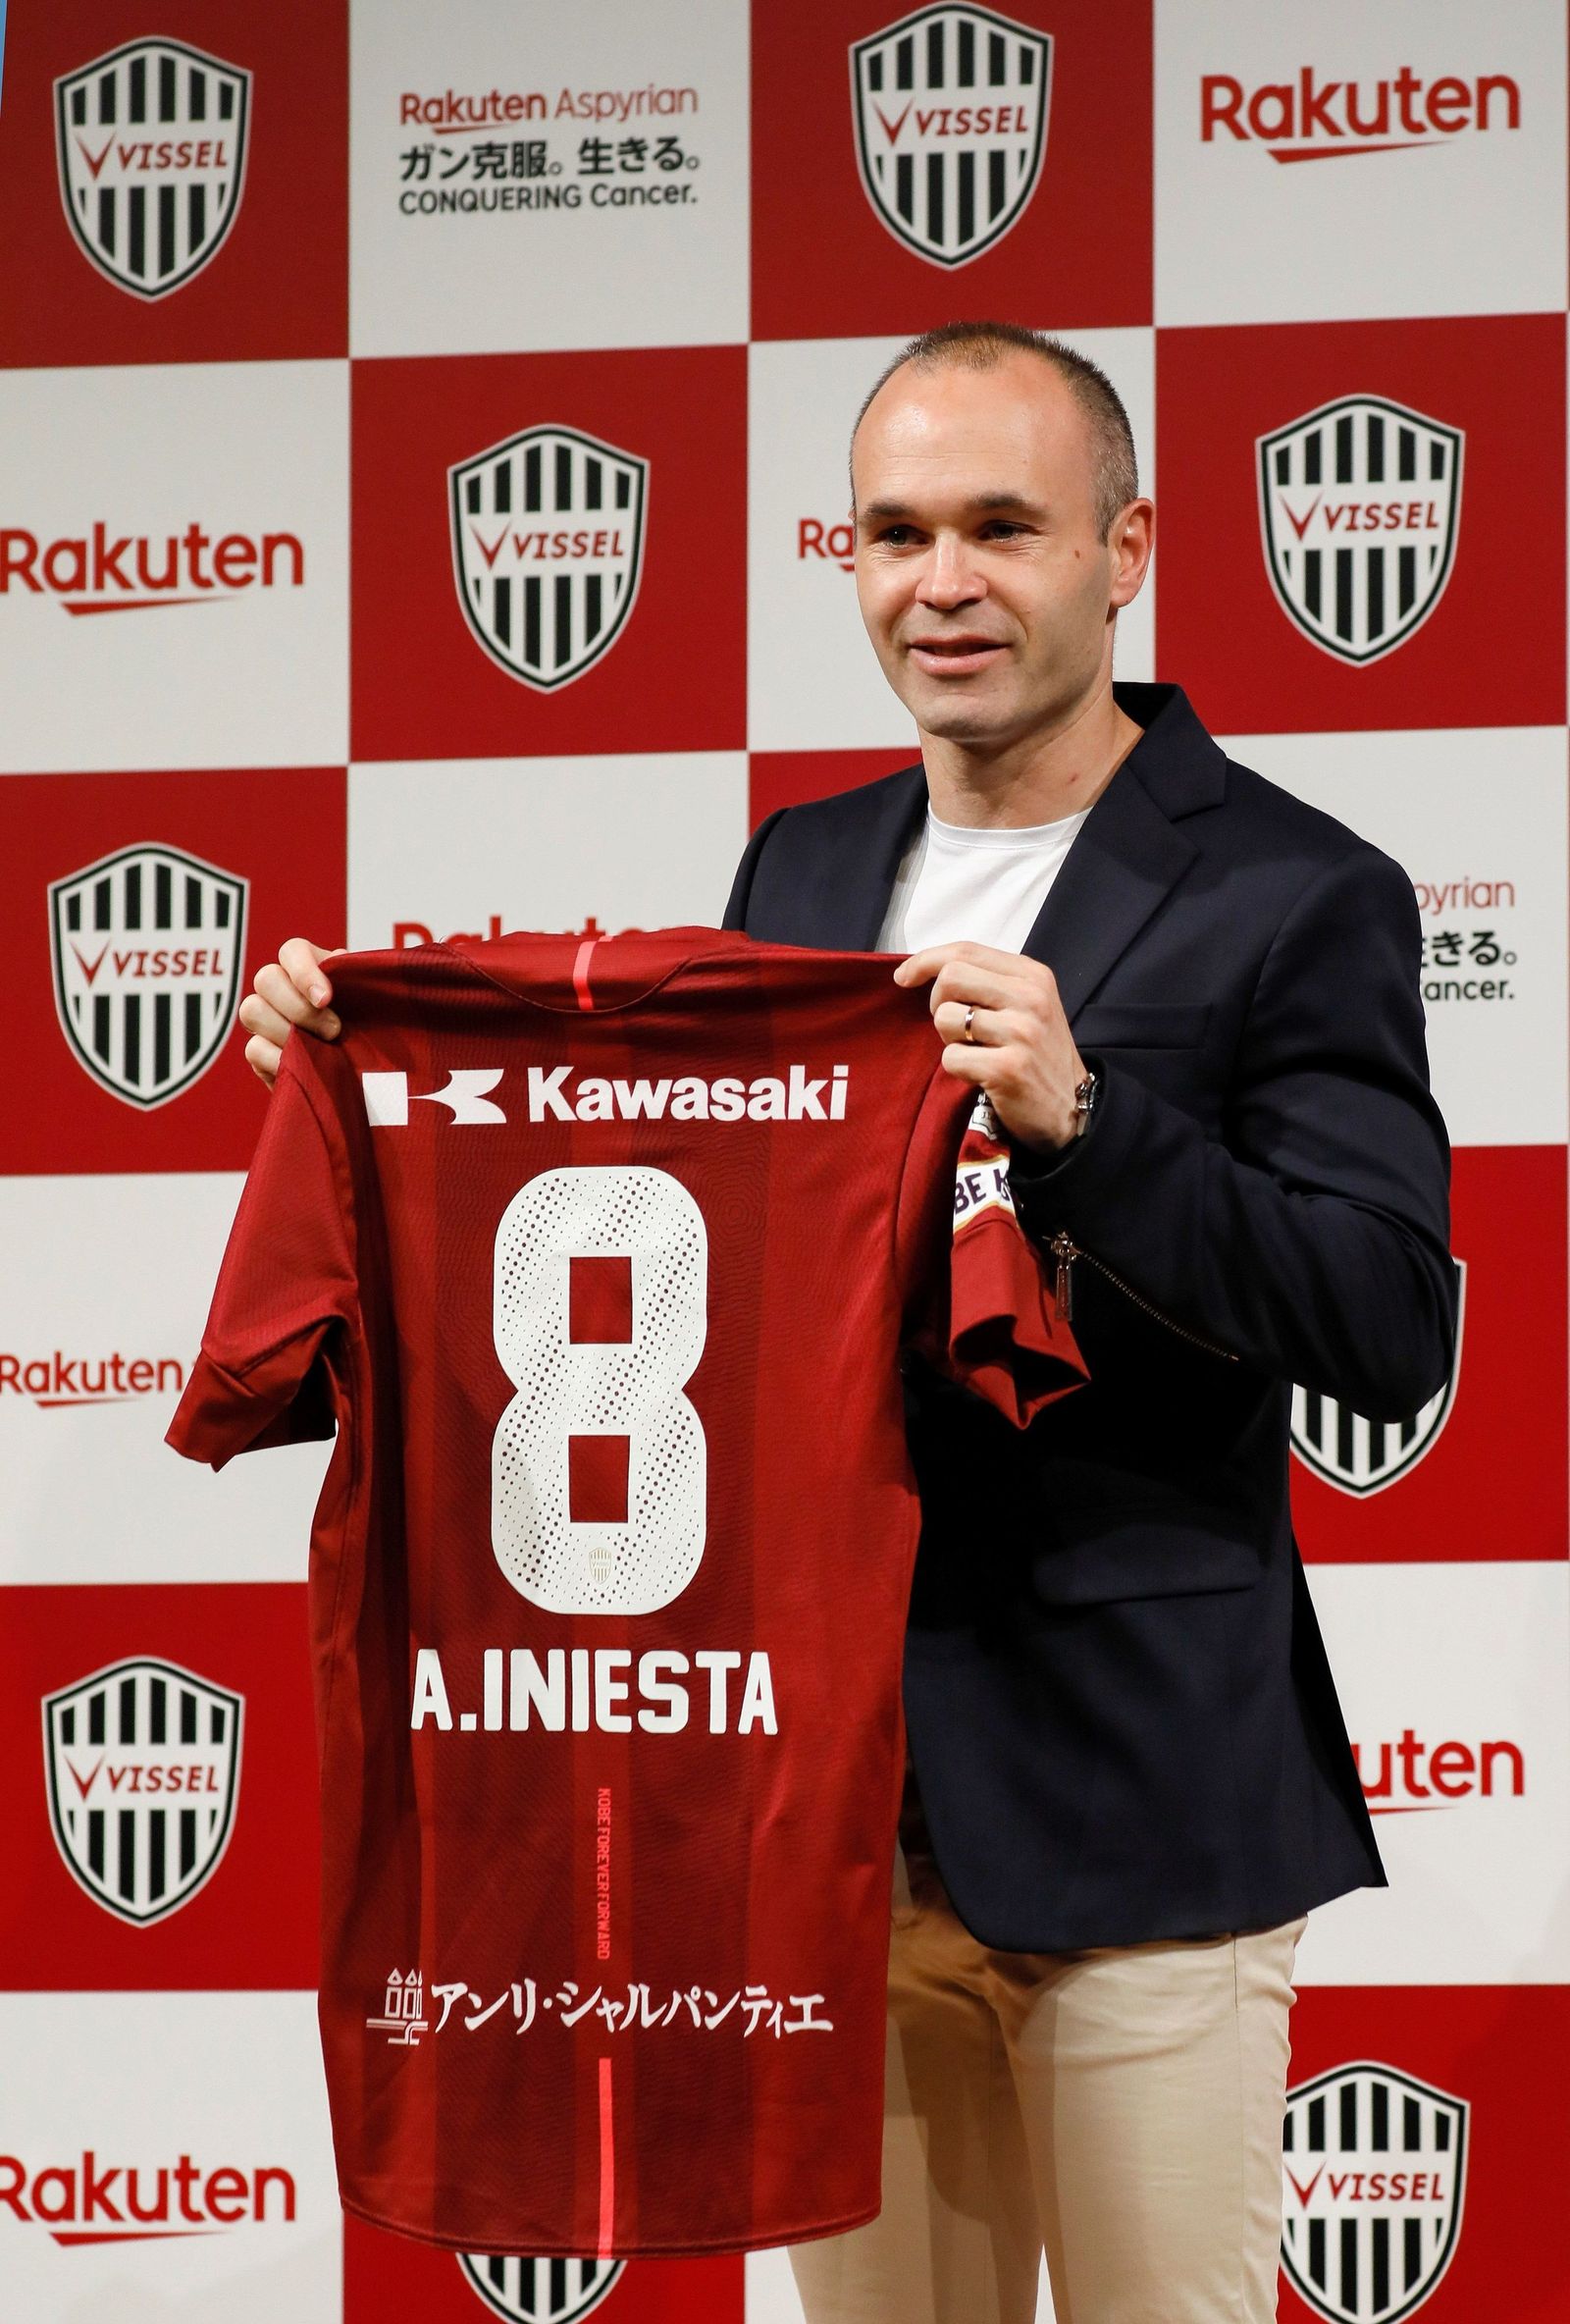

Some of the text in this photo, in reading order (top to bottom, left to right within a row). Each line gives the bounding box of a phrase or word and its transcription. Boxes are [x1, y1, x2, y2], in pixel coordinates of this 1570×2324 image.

[399, 83, 699, 125] Rakuten Aspyrian
[916, 105, 1027, 136] VISSEL
[1200, 66, 1521, 142] Rakuten
[118, 140, 228, 171] VISSEL
[398, 182, 698, 216] CONQUERING Cancer.
[1324, 501, 1439, 532] VISSEL
[0, 521, 304, 594] Rakuten
[512, 530, 624, 560] VISSEL
[798, 518, 854, 559] Ra
[112, 947, 224, 978] VISSEL
[1422, 929, 1518, 967] きる。
[1421, 978, 1515, 1001] ancer.
[528, 1065, 849, 1123] Kawasaki
[0, 1350, 184, 1395] Rakuten
[492, 1166, 708, 1615] 8
[410, 1648, 779, 1736] A.INIESTA
[107, 1765, 219, 1794] VISSEL
[597, 1788, 611, 1825] KOBE
[597, 1893, 610, 1960] FORWARD
[0, 2151, 296, 2223] Rakuten
[1328, 2172, 1445, 2202] VISSEL
